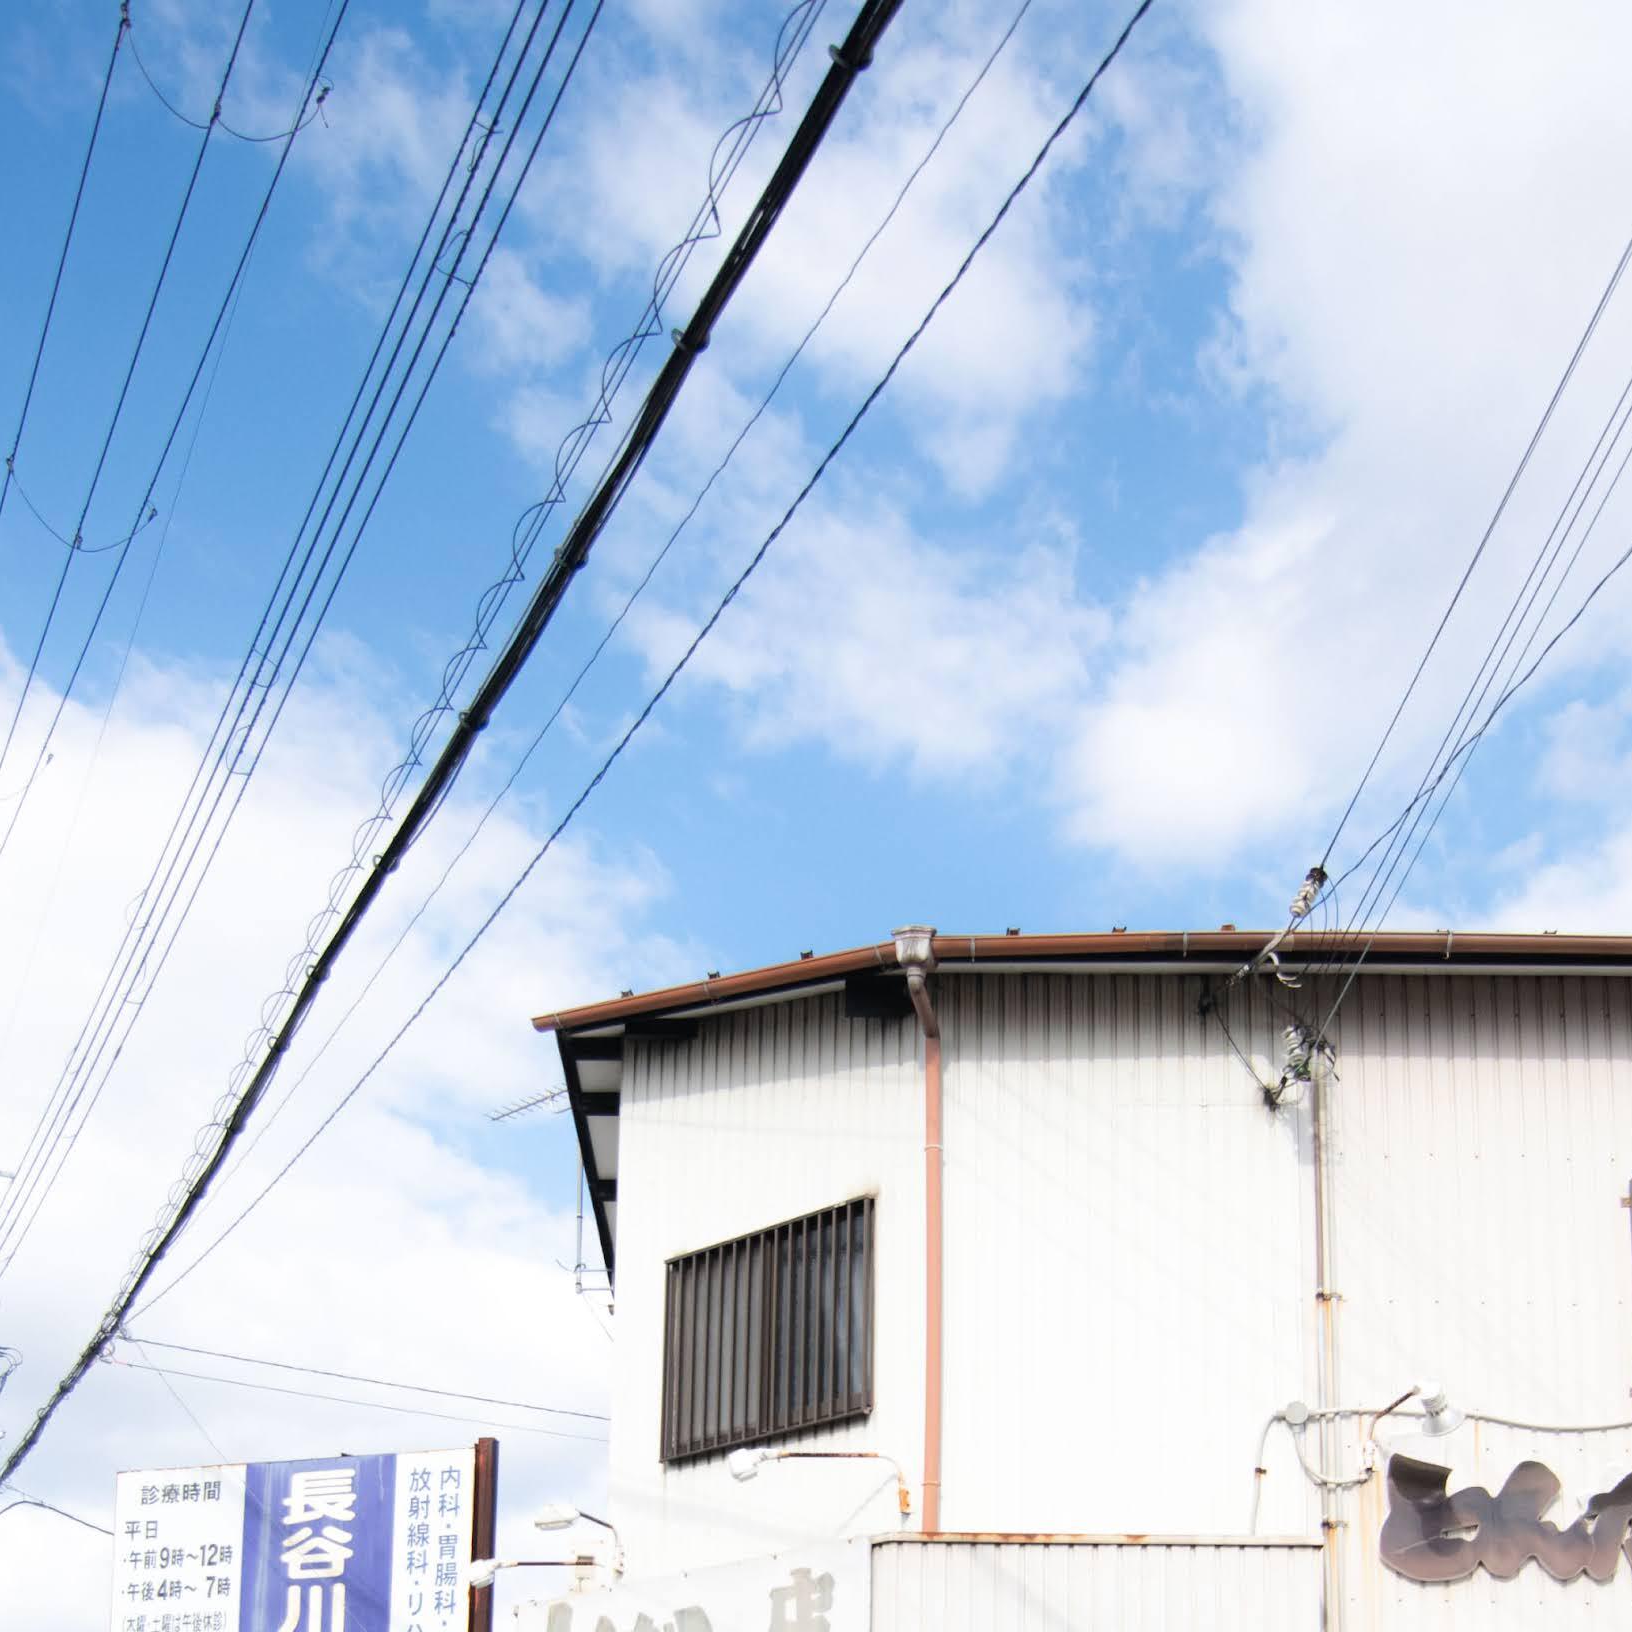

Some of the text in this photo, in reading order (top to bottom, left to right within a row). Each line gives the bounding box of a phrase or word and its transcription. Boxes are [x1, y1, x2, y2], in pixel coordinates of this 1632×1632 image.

[141, 1481, 221, 1505] 診療時間
[125, 1520, 158, 1540] 平日
